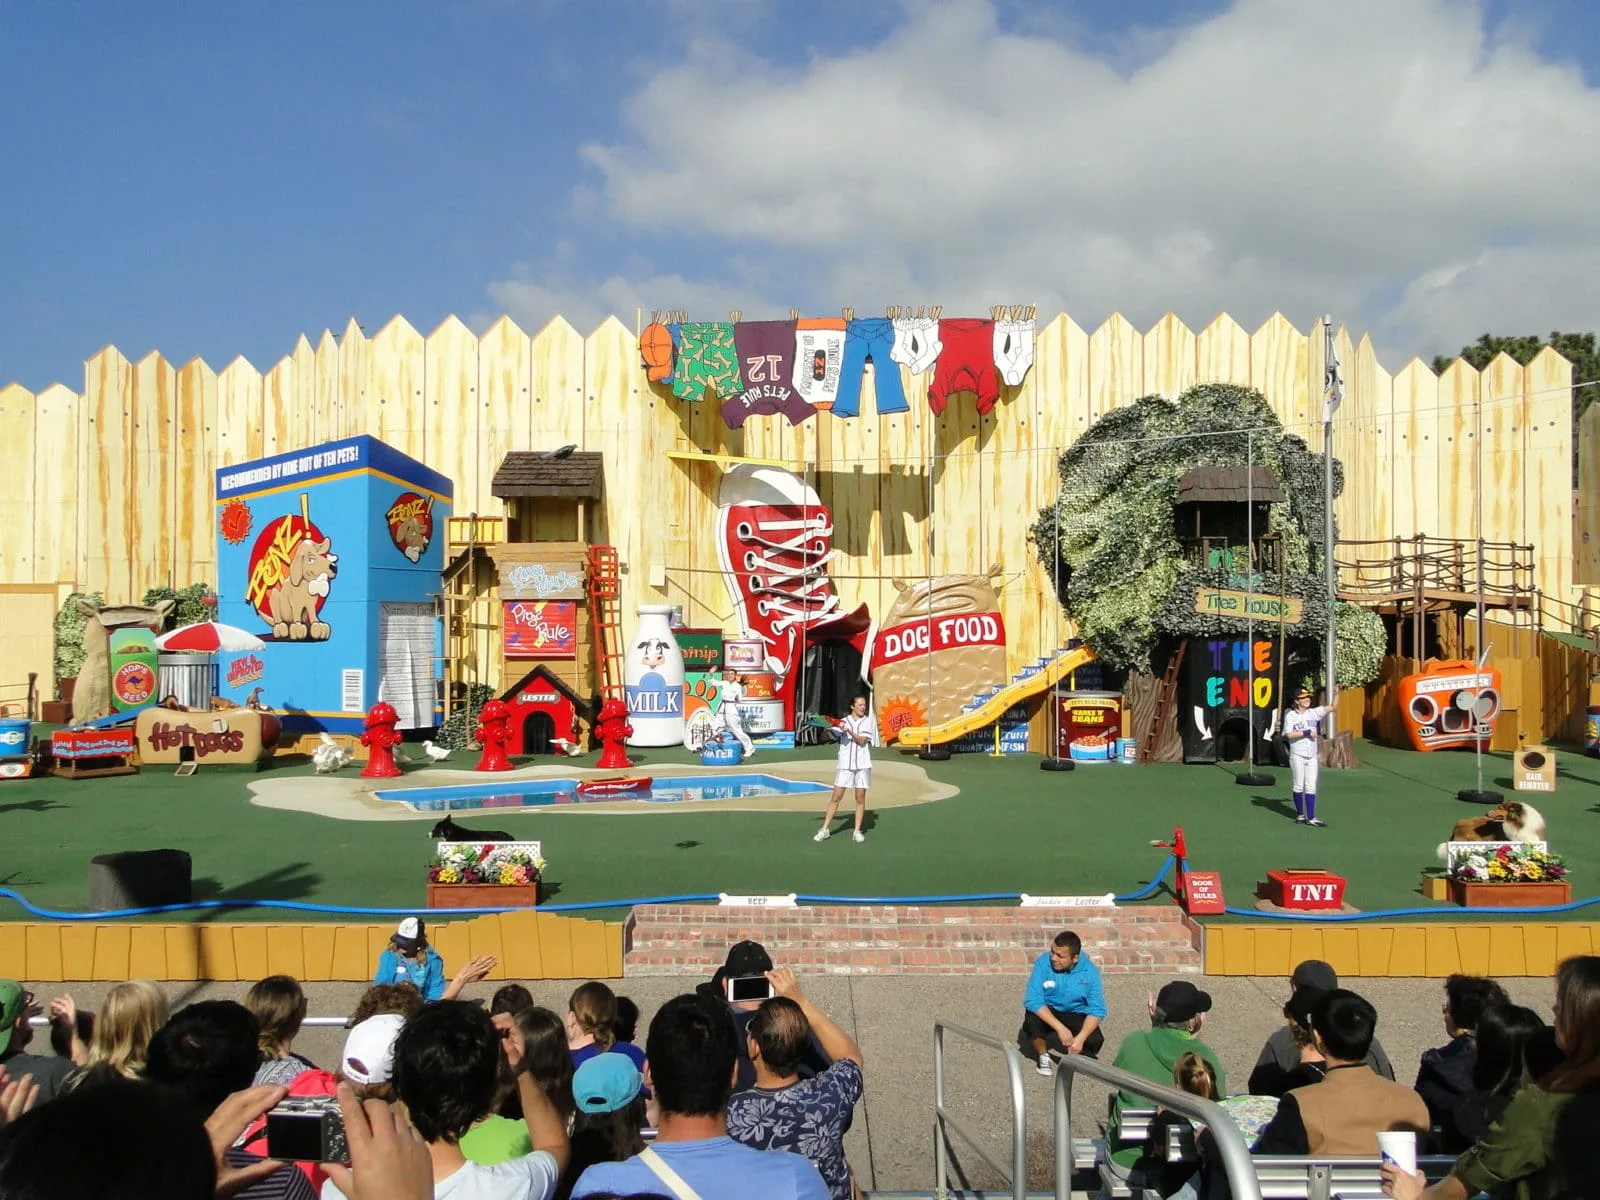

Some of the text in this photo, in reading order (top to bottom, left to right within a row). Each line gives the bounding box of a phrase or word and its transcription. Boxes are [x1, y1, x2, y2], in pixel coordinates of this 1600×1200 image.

[747, 354, 782, 382] 12
[823, 338, 839, 393] PETS RULE
[739, 384, 791, 409] PETS RULE
[221, 446, 359, 491] RECOMMENDED BY NINE OUT OF TEN PETS!
[535, 622, 570, 643] Rule
[884, 614, 999, 659] DOG FOOD
[231, 656, 248, 672] NEW
[1207, 640, 1273, 672] THE
[120, 663, 149, 676] HOP'S
[121, 690, 149, 702] SEED
[627, 690, 679, 713] MILK
[1206, 676, 1273, 708] END
[1072, 715, 1105, 723] BEANS
[1075, 898, 1102, 906] Lester
[1291, 884, 1338, 901] TNT
